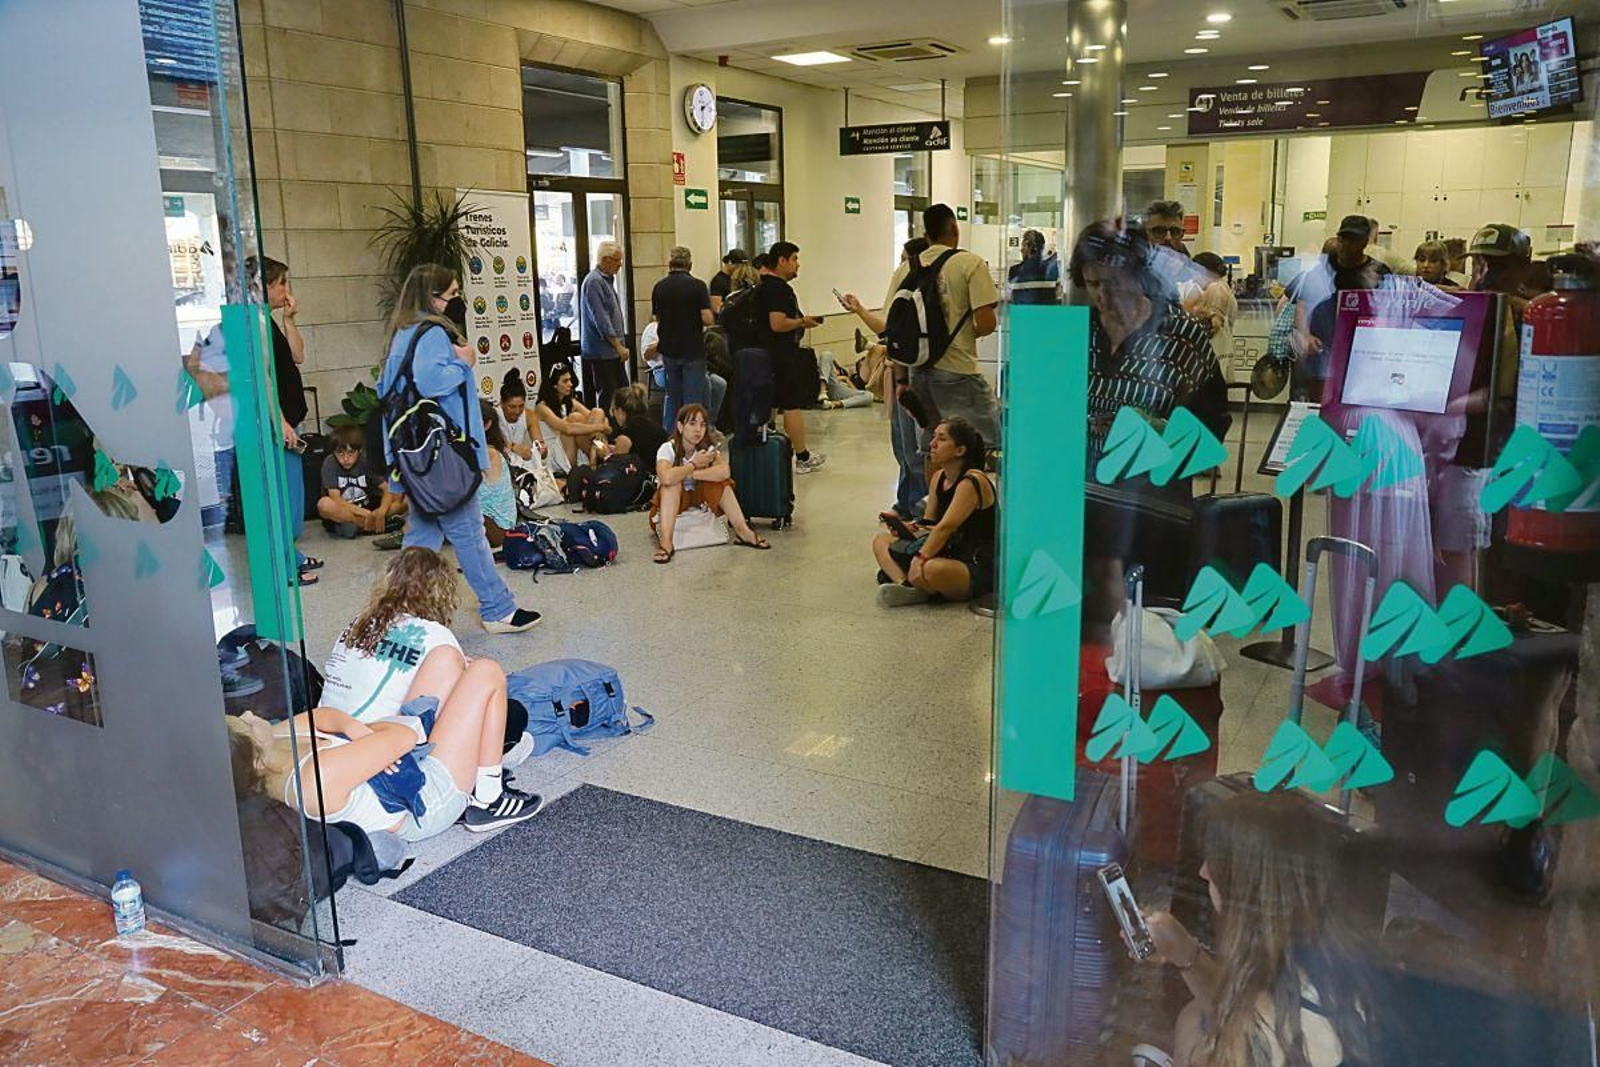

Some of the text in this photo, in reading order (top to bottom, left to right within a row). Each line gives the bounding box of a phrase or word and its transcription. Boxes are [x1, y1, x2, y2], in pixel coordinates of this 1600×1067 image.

[1220, 87, 1305, 102] Venta de billetes
[1257, 102, 1287, 113] billetes
[1246, 117, 1264, 126] sale
[862, 128, 888, 136] Atención
[896, 125, 917, 133] cliente
[863, 135, 889, 144] Atención
[899, 134, 920, 142] cliente
[924, 137, 949, 146] adif
[465, 213, 493, 222] Trenes
[465, 223, 507, 235] Turísticos
[480, 237, 509, 248] Galicia
[1010, 237, 1018, 246] 3
[1265, 234, 1273, 244] 2
